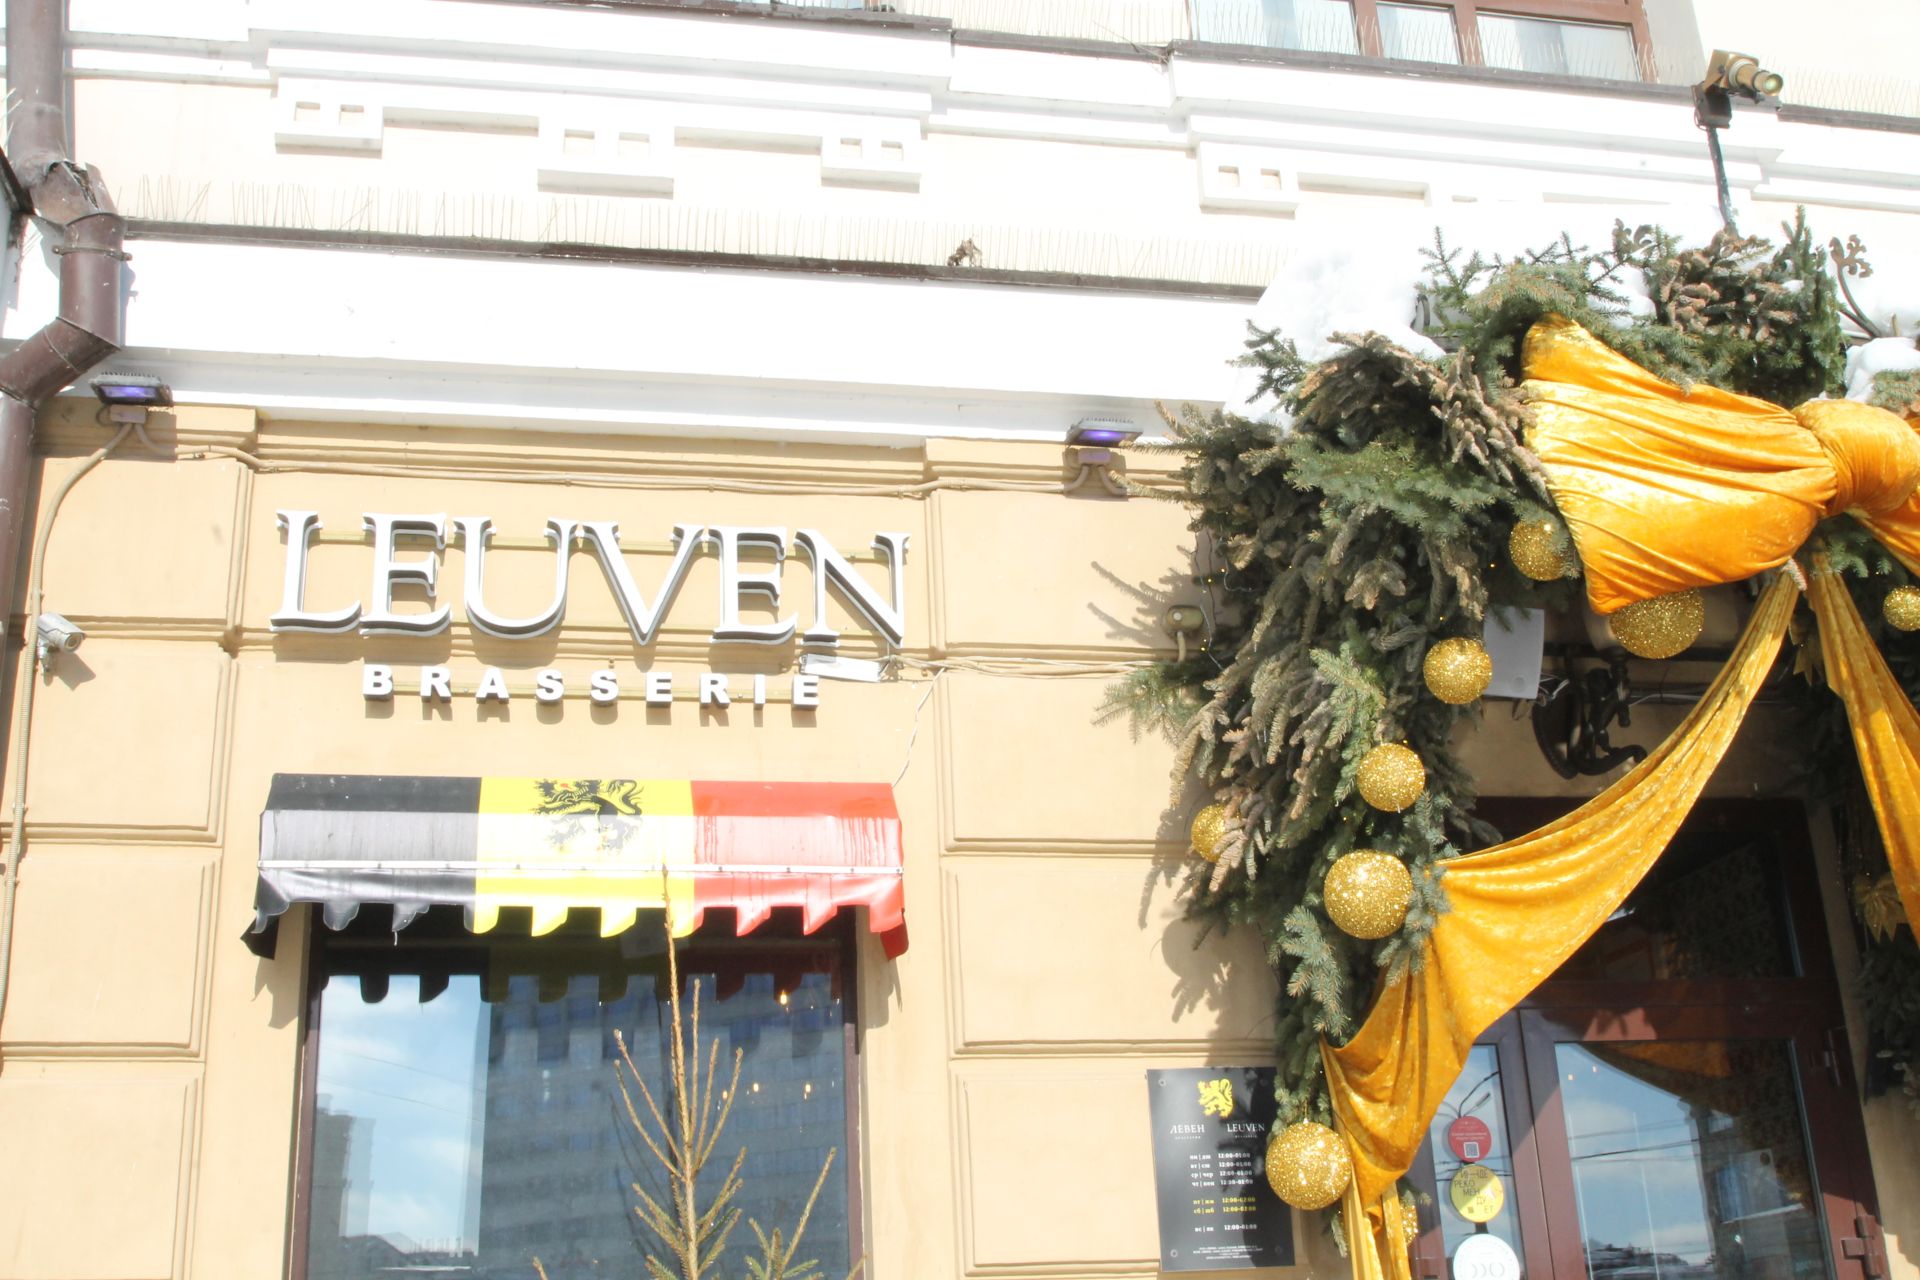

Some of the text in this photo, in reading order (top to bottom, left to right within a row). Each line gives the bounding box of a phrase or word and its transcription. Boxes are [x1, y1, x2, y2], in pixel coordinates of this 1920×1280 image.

[270, 509, 911, 649] LEUVEN
[362, 663, 819, 709] BRASSERIE
[1227, 1123, 1265, 1133] LEUVEN
